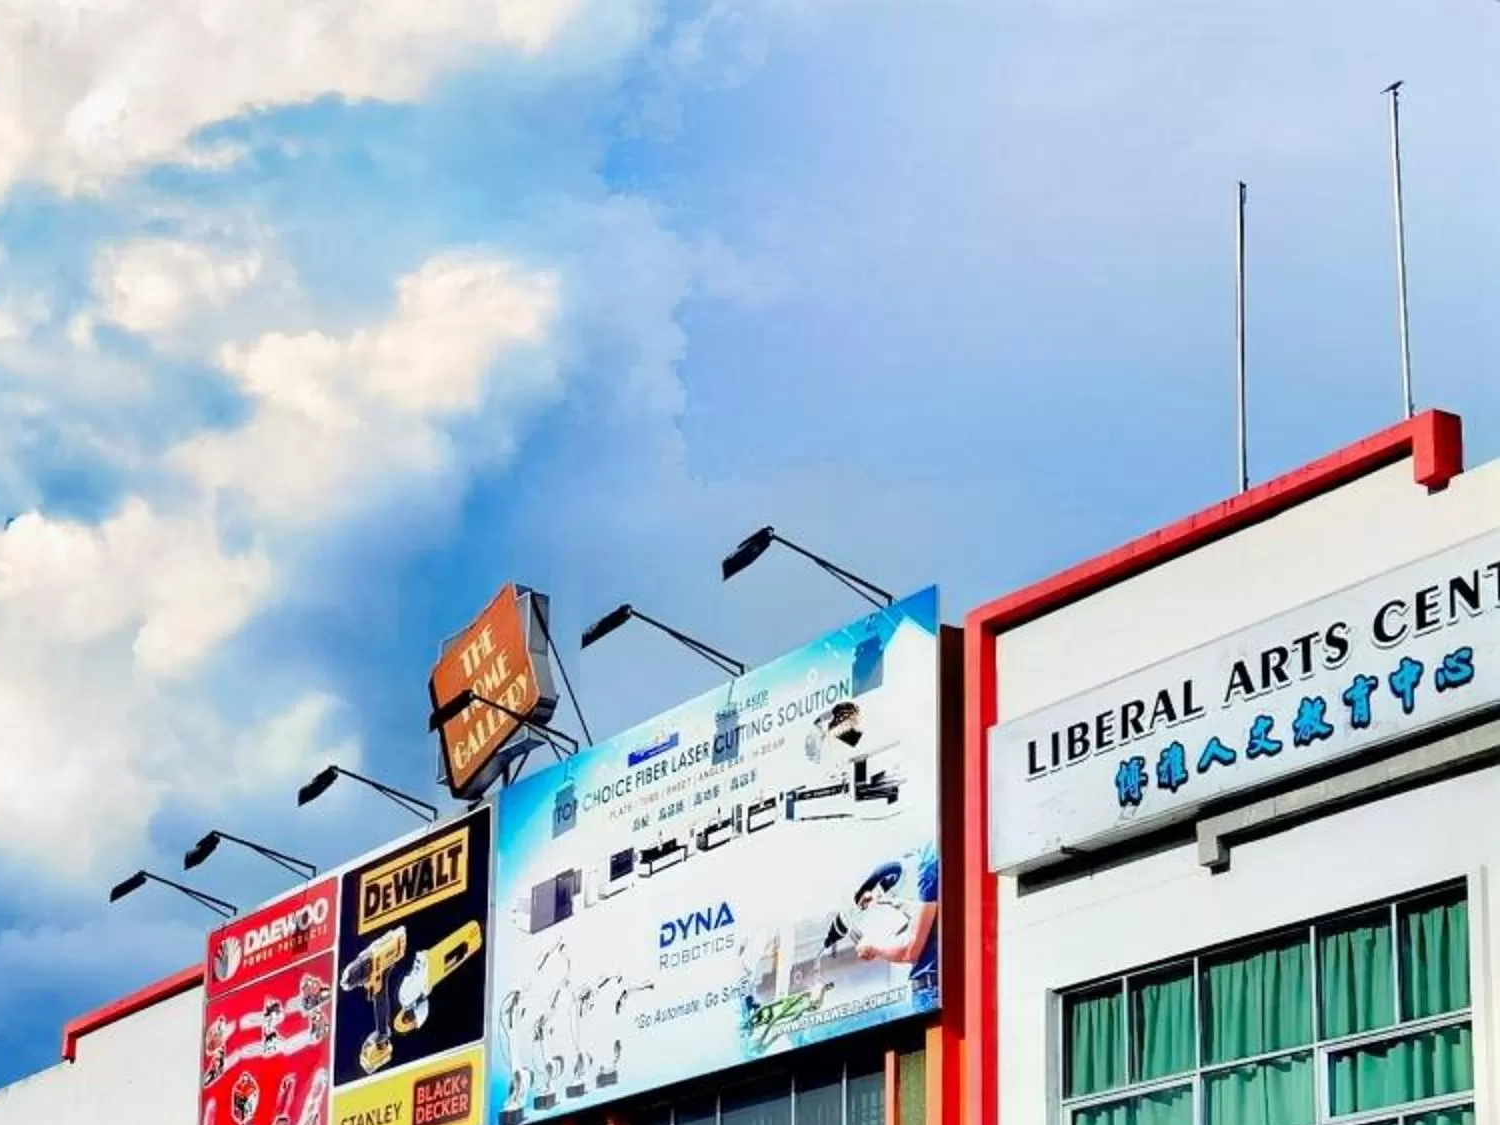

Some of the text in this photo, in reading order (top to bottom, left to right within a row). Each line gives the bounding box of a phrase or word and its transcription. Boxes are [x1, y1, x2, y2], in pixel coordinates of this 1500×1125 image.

[460, 624, 498, 678] THE
[1027, 678, 1205, 776] LIBERAL
[1224, 621, 1350, 701] ARTS
[581, 774, 633, 813] CHOICE
[635, 759, 669, 790] FIBER
[671, 741, 711, 773] LASER
[713, 714, 774, 755] CUTTING
[776, 678, 851, 728] SOLUTION
[243, 897, 330, 957] DAEWOO
[659, 901, 735, 949] DYNA
[415, 1093, 469, 1125] DECKER
